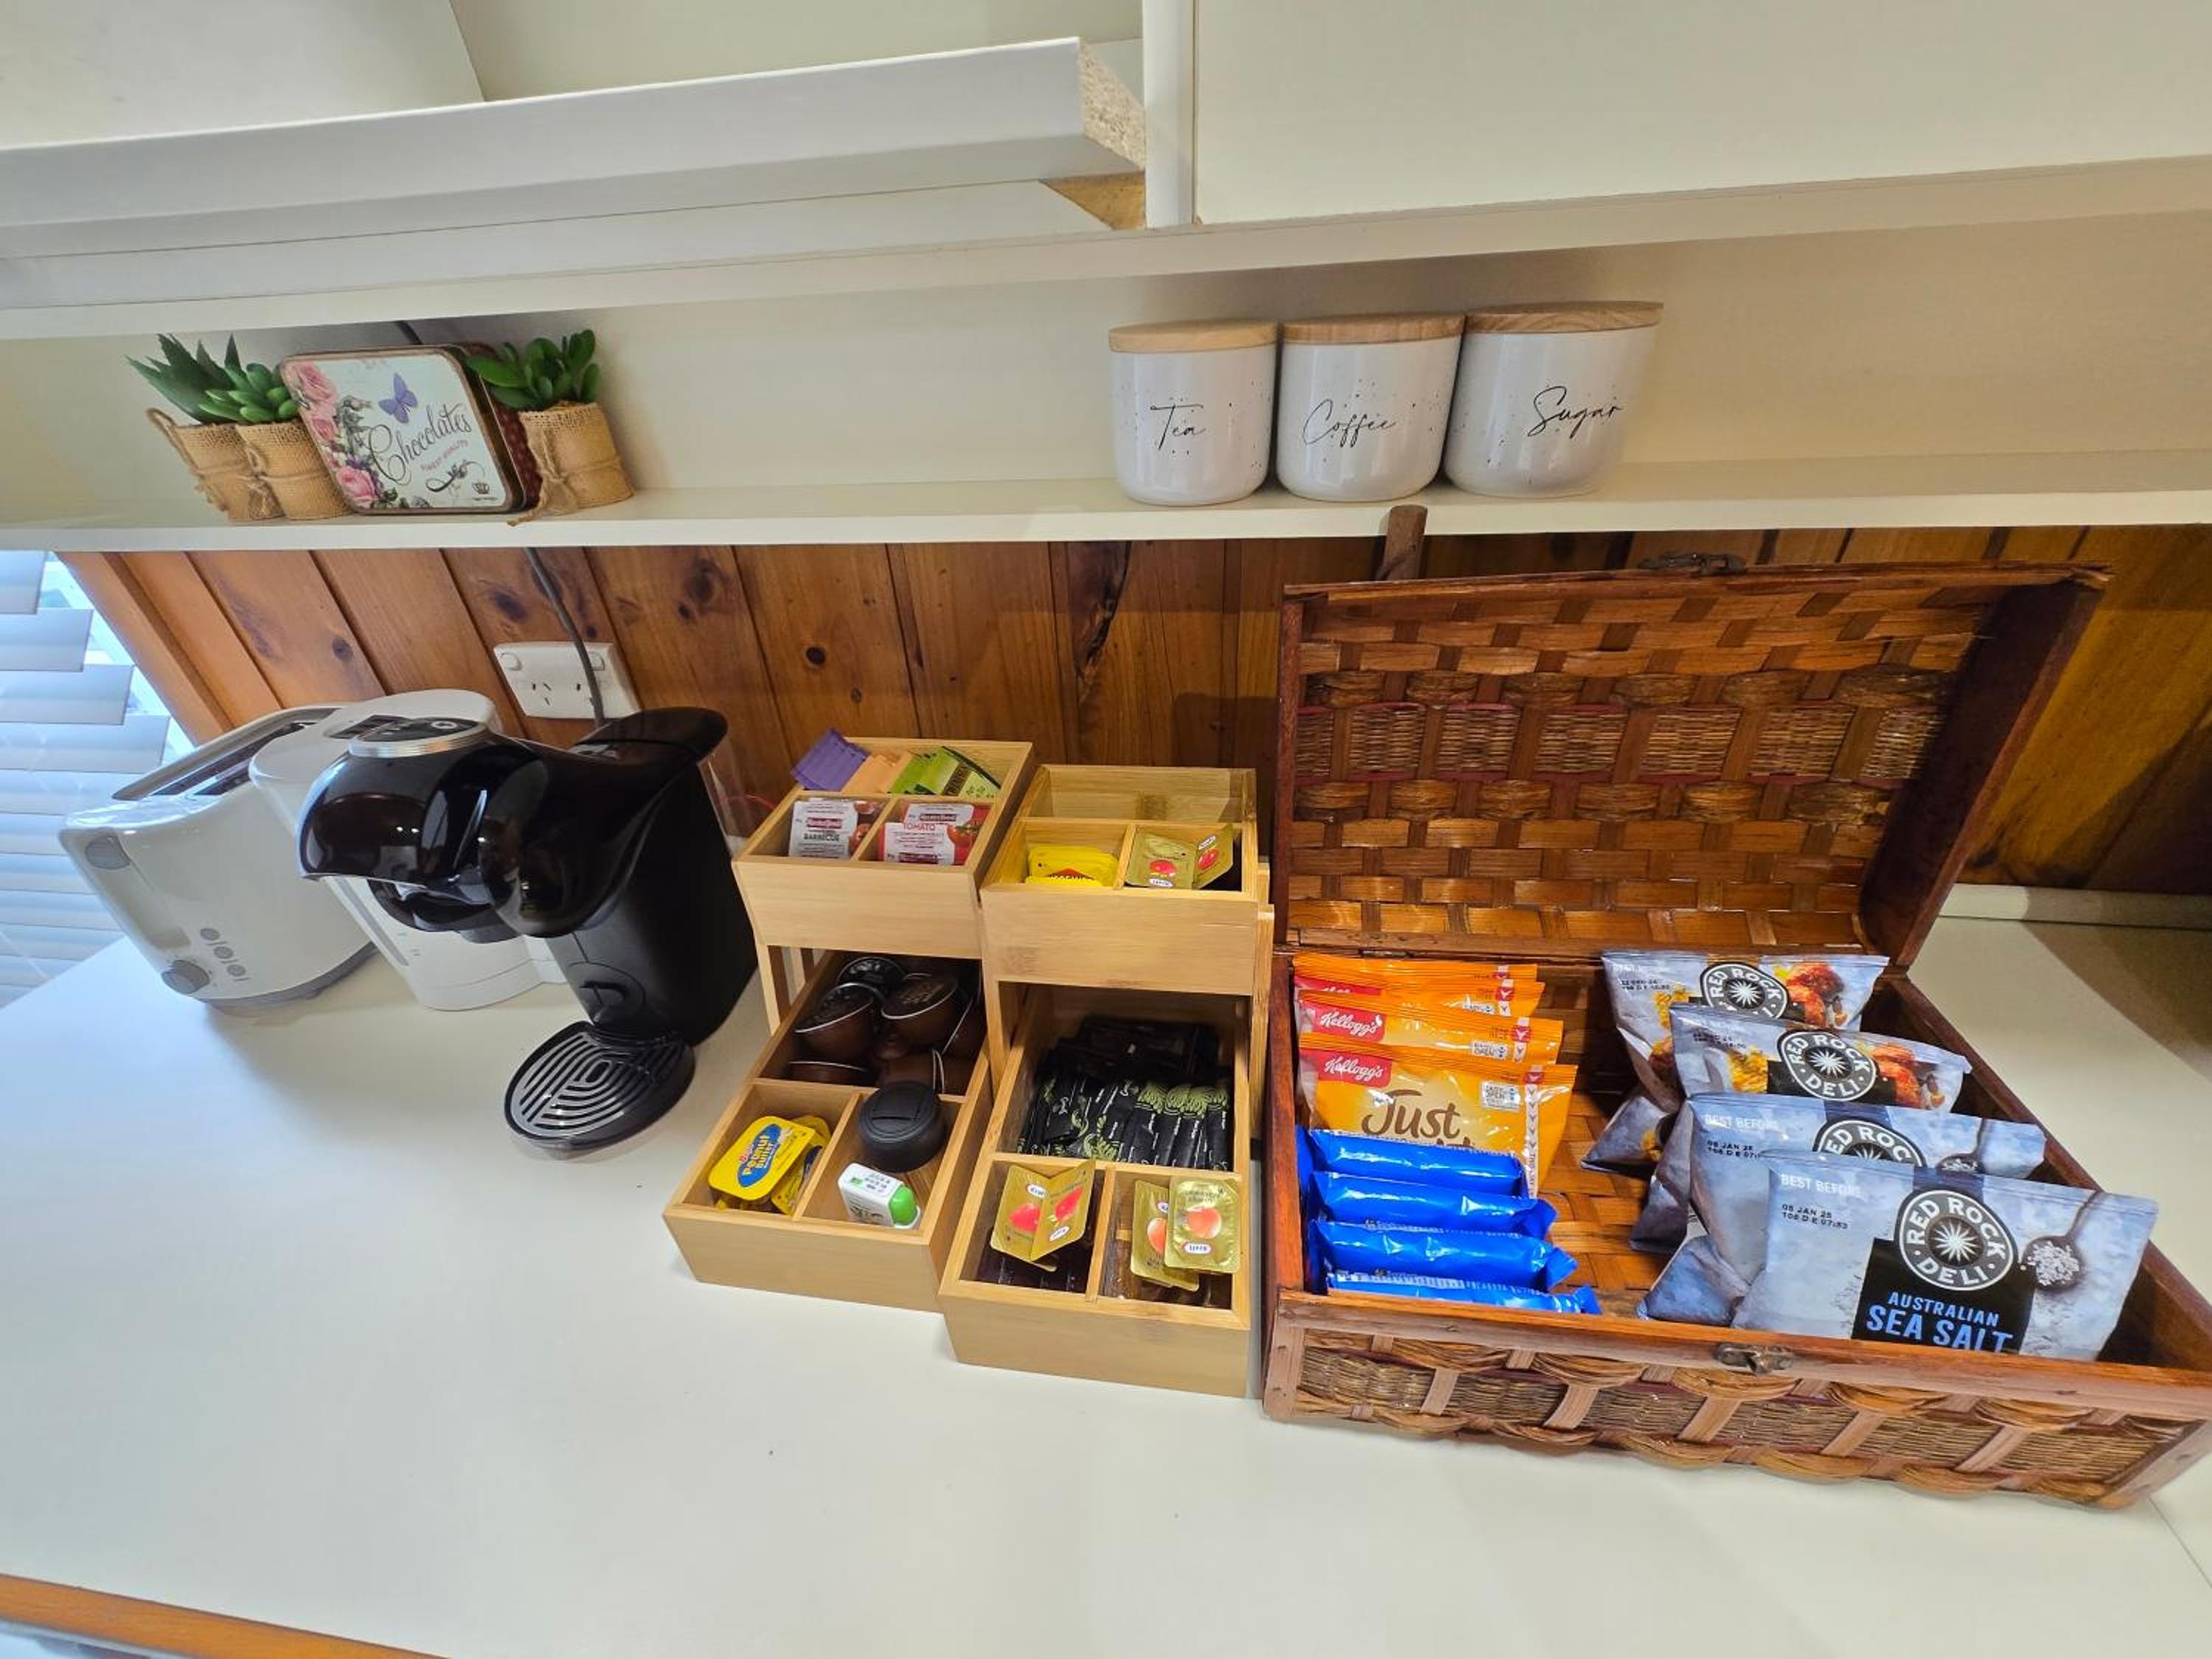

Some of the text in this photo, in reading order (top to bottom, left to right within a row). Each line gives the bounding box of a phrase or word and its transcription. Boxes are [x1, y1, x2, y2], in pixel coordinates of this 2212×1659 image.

[1150, 403, 1206, 449] Tea
[1302, 399, 1397, 448] Coffee
[1527, 386, 1624, 439] Sugar
[368, 403, 473, 486] Chocolates
[903, 823, 936, 831] TOMATO
[1711, 968, 1782, 1000] RED ROCK
[1320, 1011, 1378, 1039] Kellogg's
[1324, 1057, 1384, 1081] Kellogg's
[1787, 1037, 1809, 1065] RED
[1813, 1034, 1871, 1073] ROCK
[1805, 1074, 1860, 1097] DELI
[1361, 1089, 1461, 1140] Just
[1824, 1125, 1913, 1163] ED ROC
[1781, 1173, 1811, 1190] BEST
[1797, 1207, 1817, 1216] JAN
[1907, 1196, 2006, 1261] RED ROCK
[1916, 1256, 1989, 1286] DELI
[1887, 1291, 2000, 1328] AUSTRALIAN
[1866, 1304, 2014, 1354] SEA SALT
